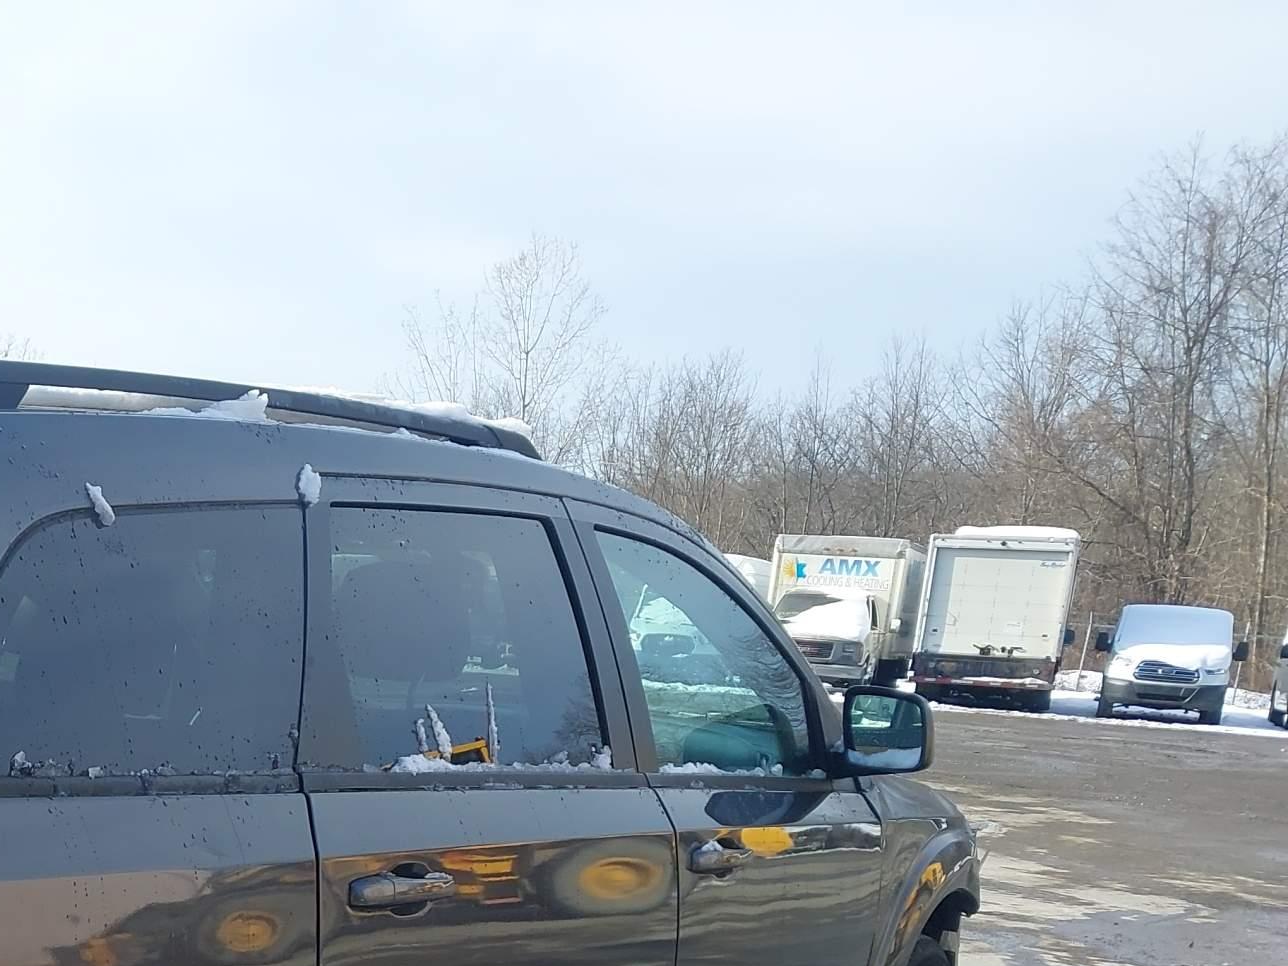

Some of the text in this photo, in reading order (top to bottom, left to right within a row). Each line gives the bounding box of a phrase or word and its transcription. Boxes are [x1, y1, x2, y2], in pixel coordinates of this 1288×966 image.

[819, 558, 881, 577] AMX
[806, 575, 844, 588] COOLING
[854, 577, 889, 590] HEATING
